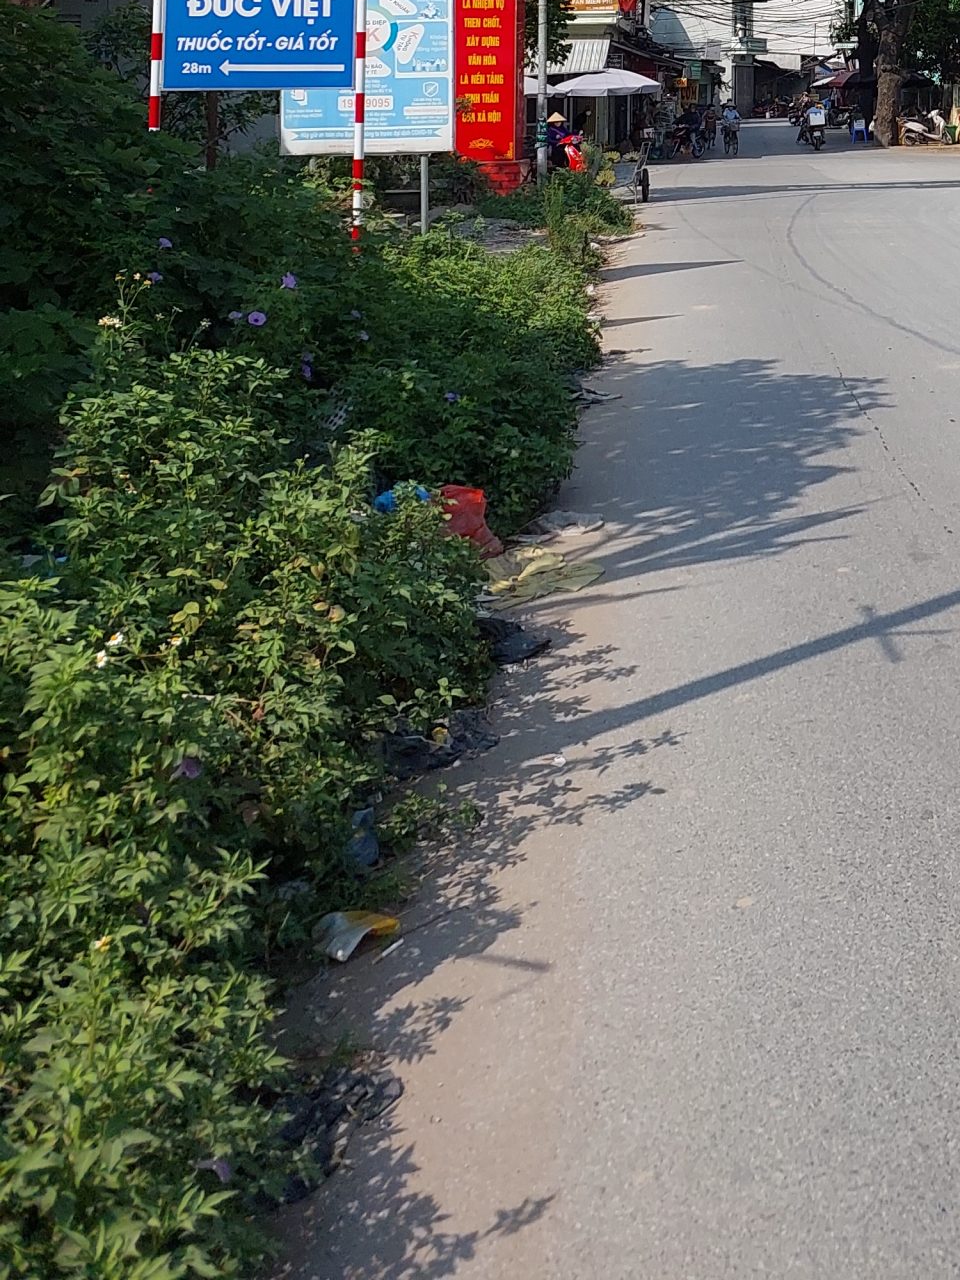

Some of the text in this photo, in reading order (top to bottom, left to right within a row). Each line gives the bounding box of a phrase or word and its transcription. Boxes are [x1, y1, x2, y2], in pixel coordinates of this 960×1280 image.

[464, 18, 481, 28] THEN
[176, 30, 233, 51] THUỐC
[236, 30, 266, 51] TỐT
[275, 32, 304, 50] GIÁ
[308, 30, 338, 50] TỐT
[466, 35, 500, 48] XÂY DỰNG
[468, 54, 482, 66] VĂN
[182, 62, 212, 74] 28m
[460, 72, 504, 84] LÀ NỀN TẢNG
[342, 98, 390, 108] 199095
[482, 91, 500, 104] THẦN
[477, 110, 486, 122] XÃ
